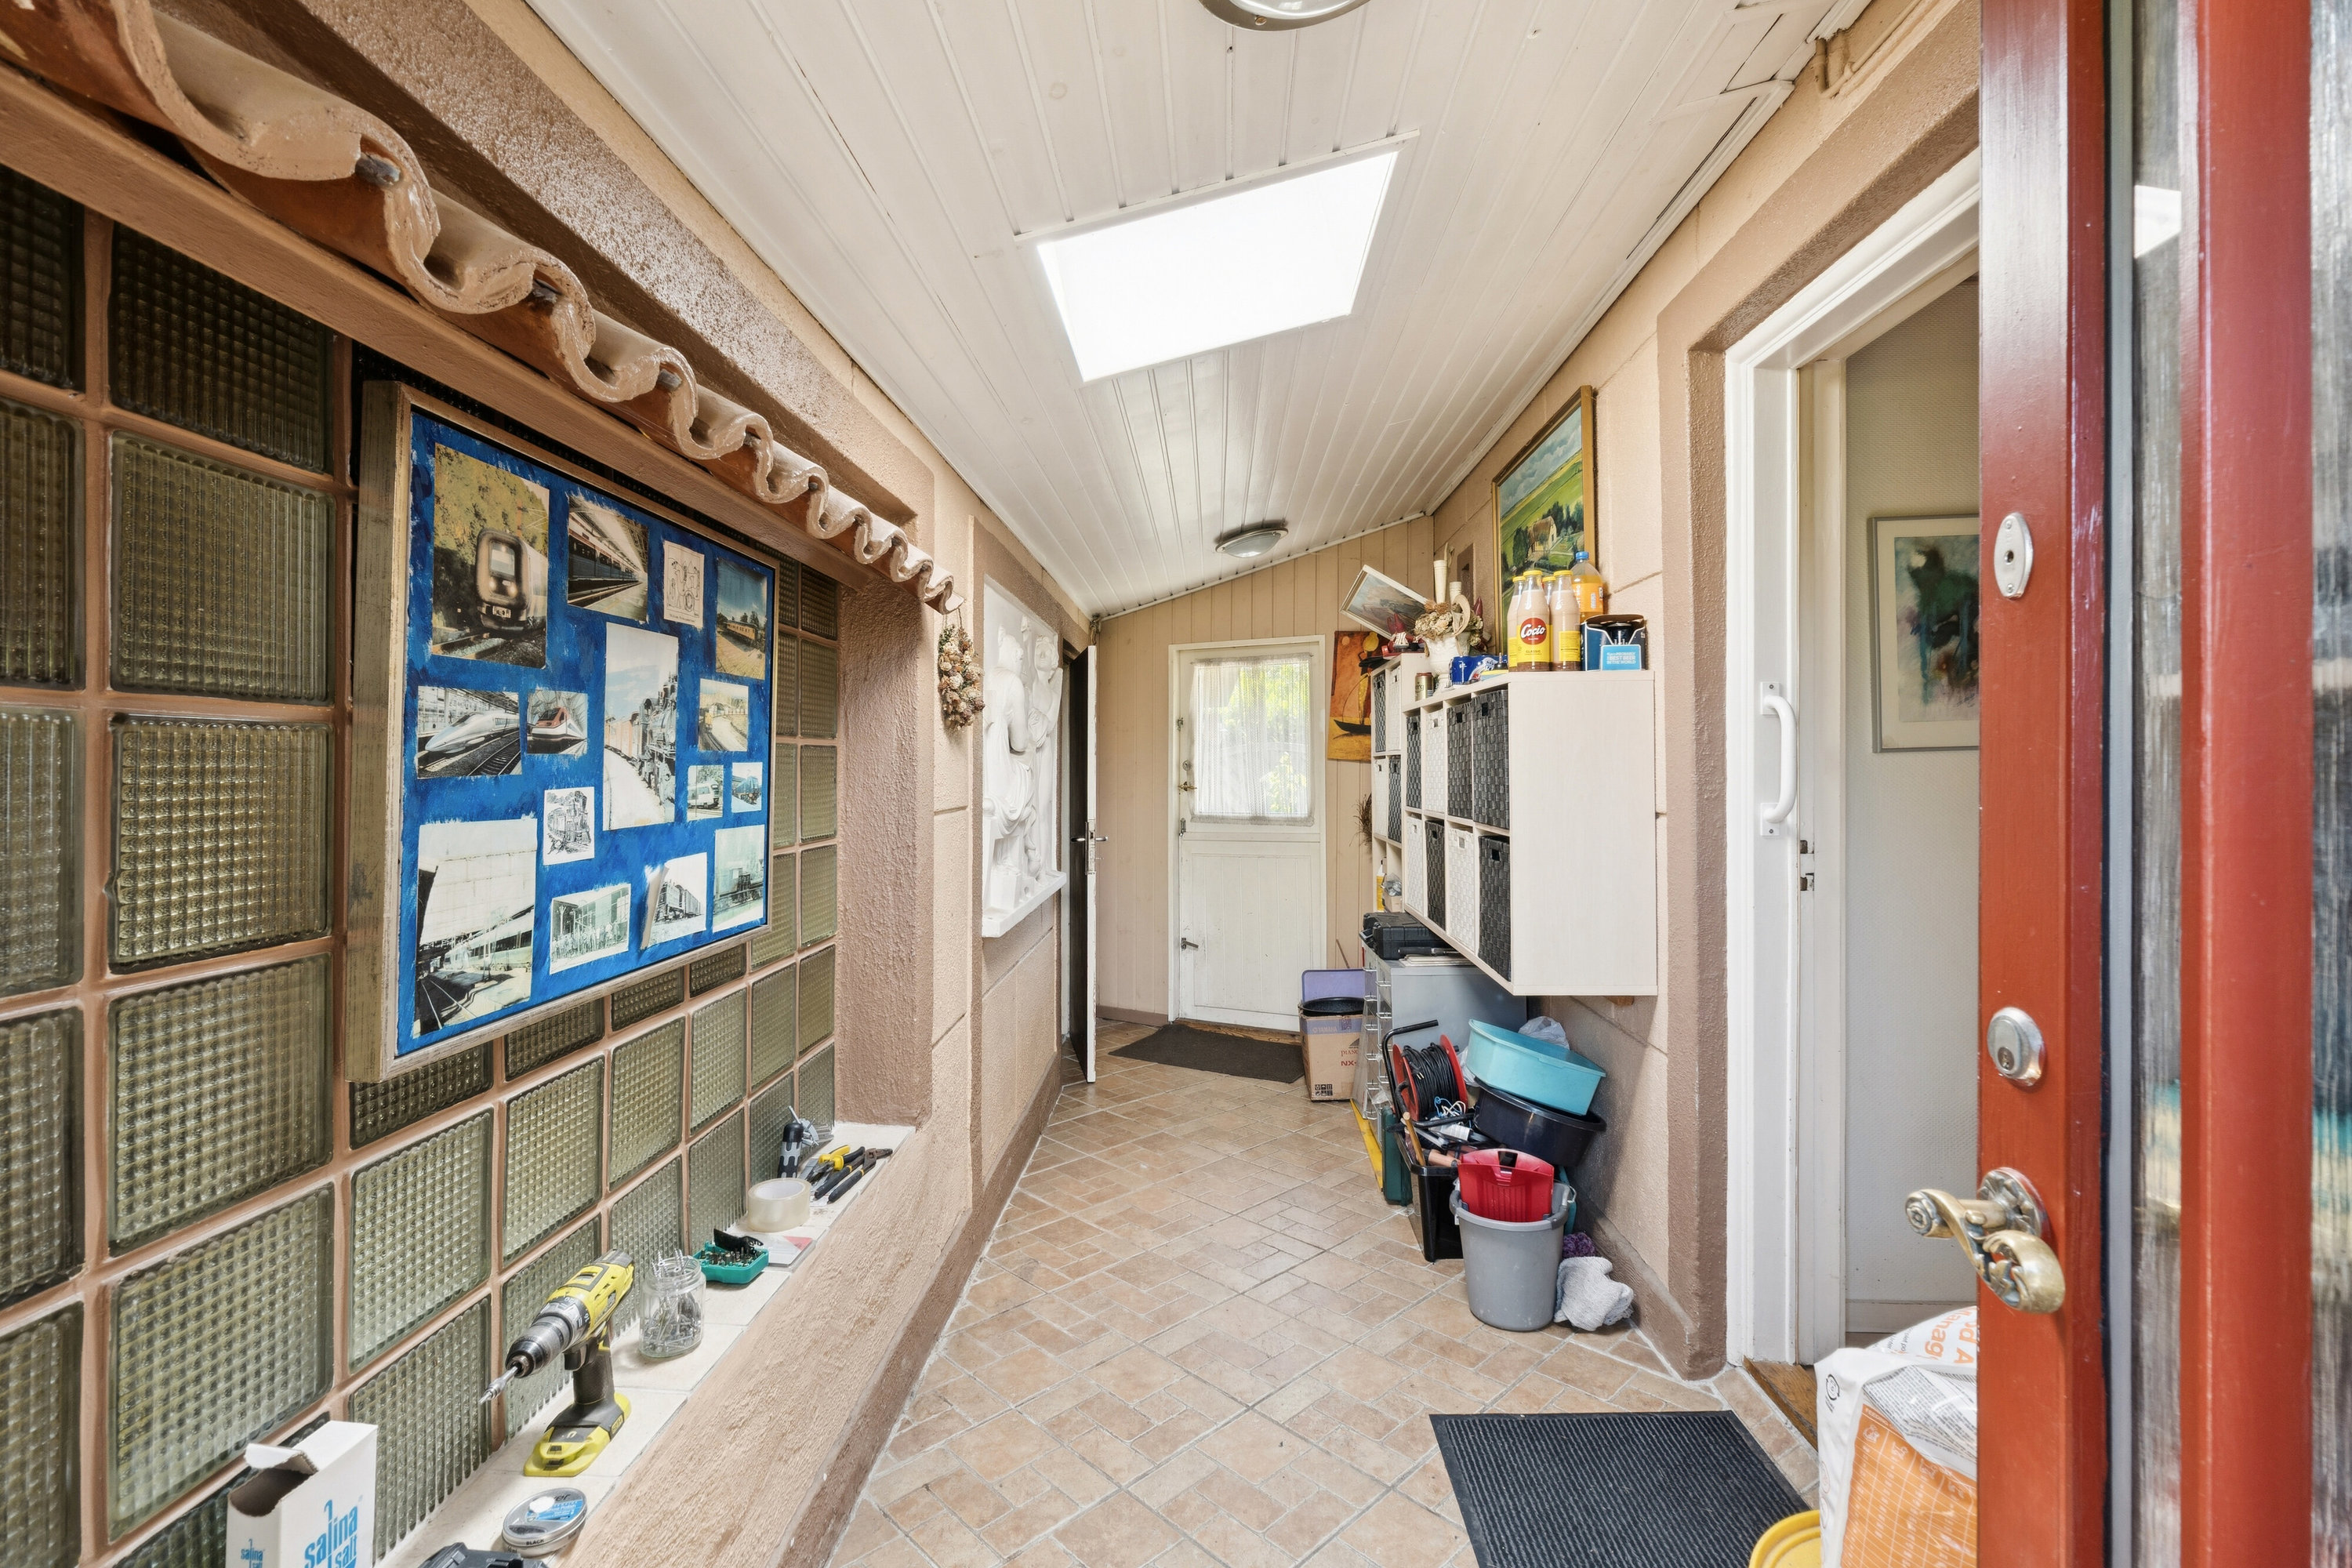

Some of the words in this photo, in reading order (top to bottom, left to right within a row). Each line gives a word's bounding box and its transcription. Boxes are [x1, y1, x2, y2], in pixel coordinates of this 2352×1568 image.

[1521, 624, 1546, 638] Cocio
[304, 1499, 358, 1566] salina
[241, 1538, 264, 1561] salina
[335, 1534, 358, 1568] salt
